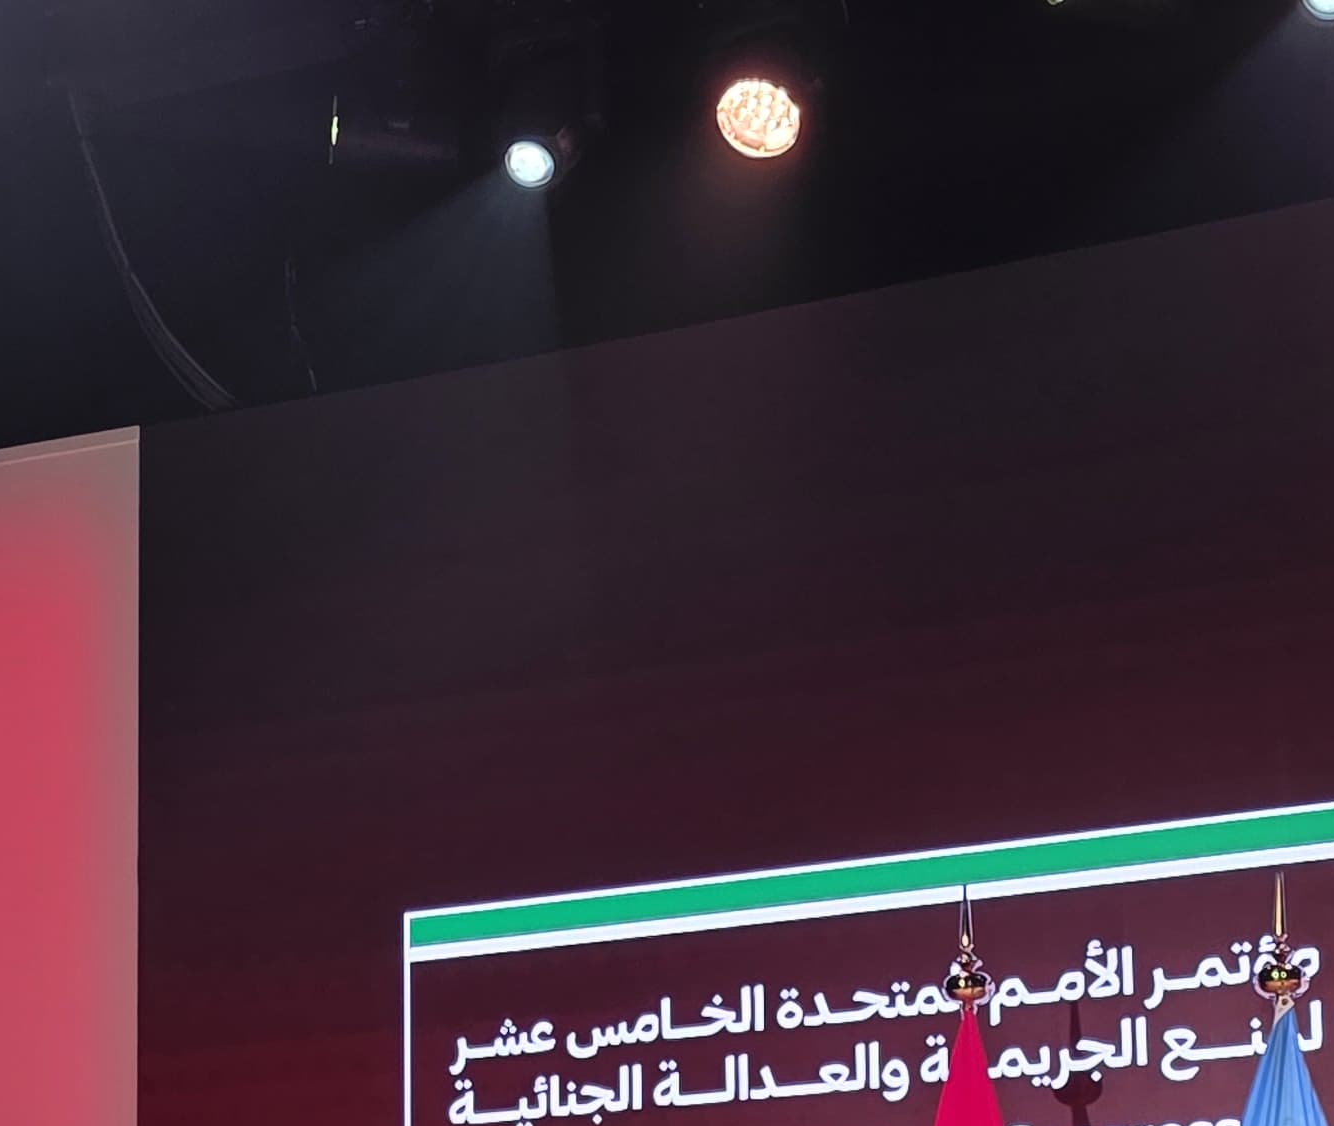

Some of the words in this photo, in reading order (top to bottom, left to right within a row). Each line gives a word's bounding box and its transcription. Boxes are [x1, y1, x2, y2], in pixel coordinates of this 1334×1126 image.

[989, 940, 1134, 1026] الأمم
[449, 1019, 556, 1075] عشر
[567, 984, 765, 1059] الخامس
[652, 1040, 910, 1102] والعدالة
